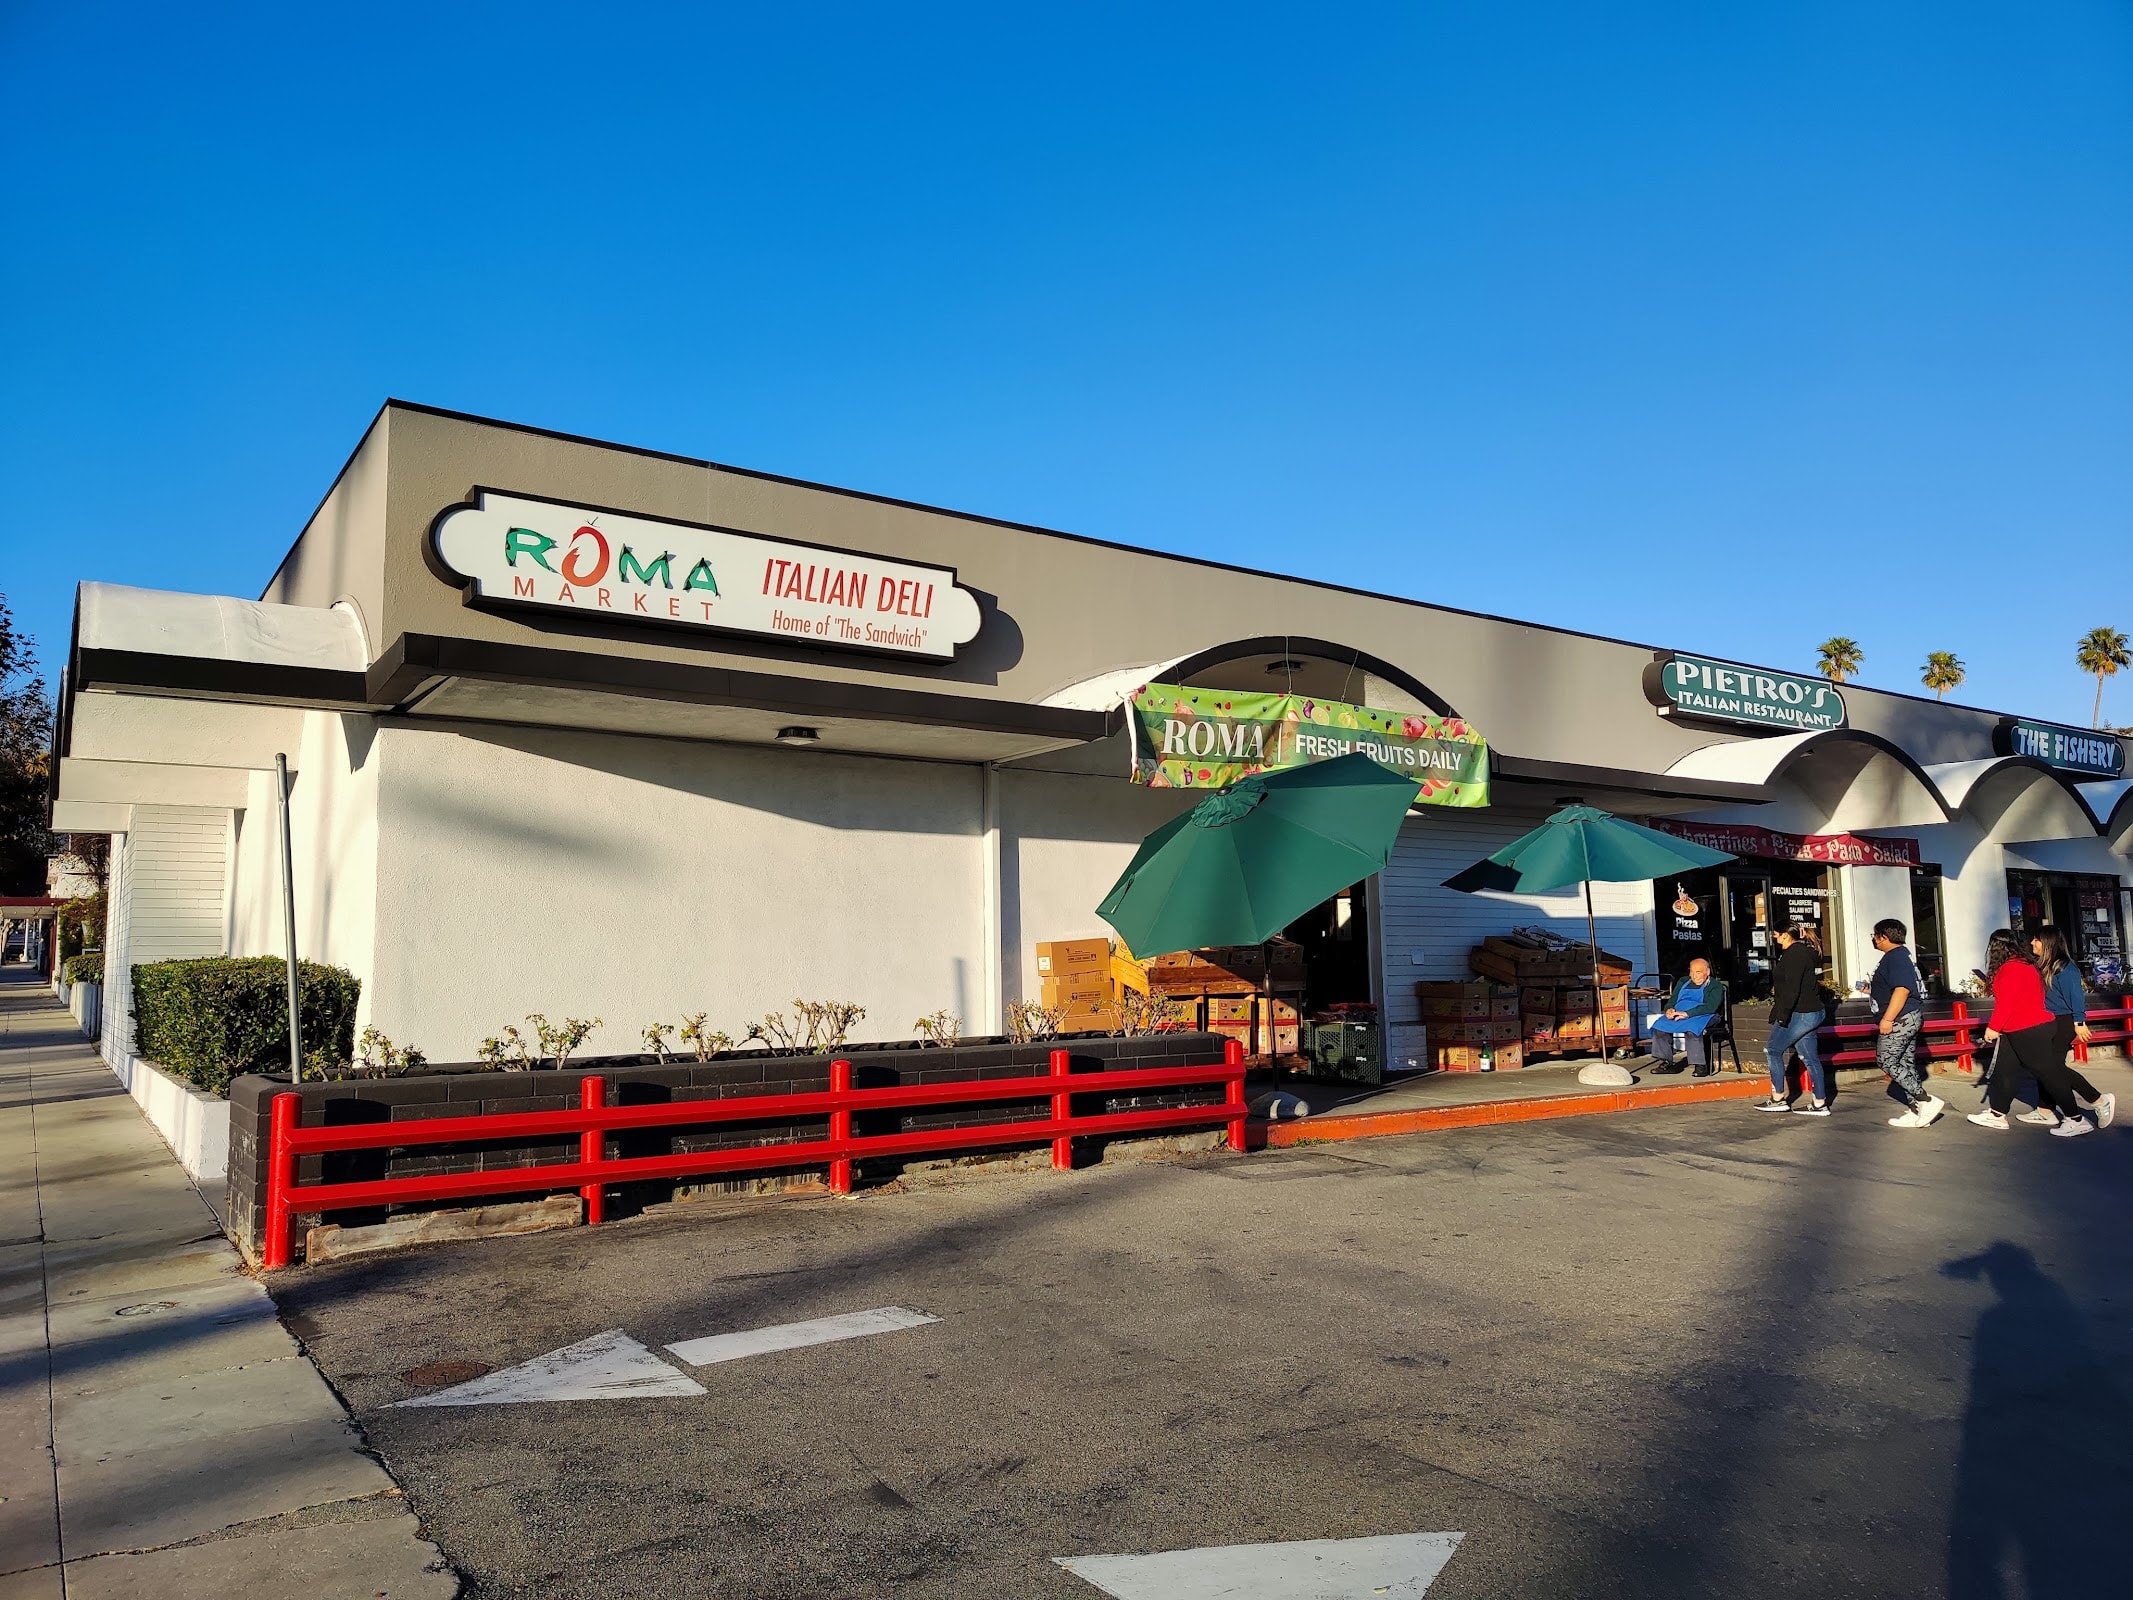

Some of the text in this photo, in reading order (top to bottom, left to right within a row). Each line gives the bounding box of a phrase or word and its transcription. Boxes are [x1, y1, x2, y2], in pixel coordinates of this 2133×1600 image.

[506, 524, 721, 598] ROMA
[514, 575, 714, 621] MARKET
[762, 558, 934, 618] ITALIAN DELI
[772, 609, 929, 649] Home of "The Sandwich"
[1676, 661, 1830, 708] PIETRO'S
[1677, 690, 1832, 727] ITALIAN RESTAURANT
[1161, 718, 1267, 760] ROMA
[1295, 733, 1463, 772] FRESH FRUITS DAILY
[2017, 727, 2116, 769] THE FISHERY
[1660, 821, 1758, 853] Sbmarines
[1873, 841, 1911, 864] Salad
[1672, 929, 1703, 941] Pastas
[1675, 916, 1699, 929] Pizza
